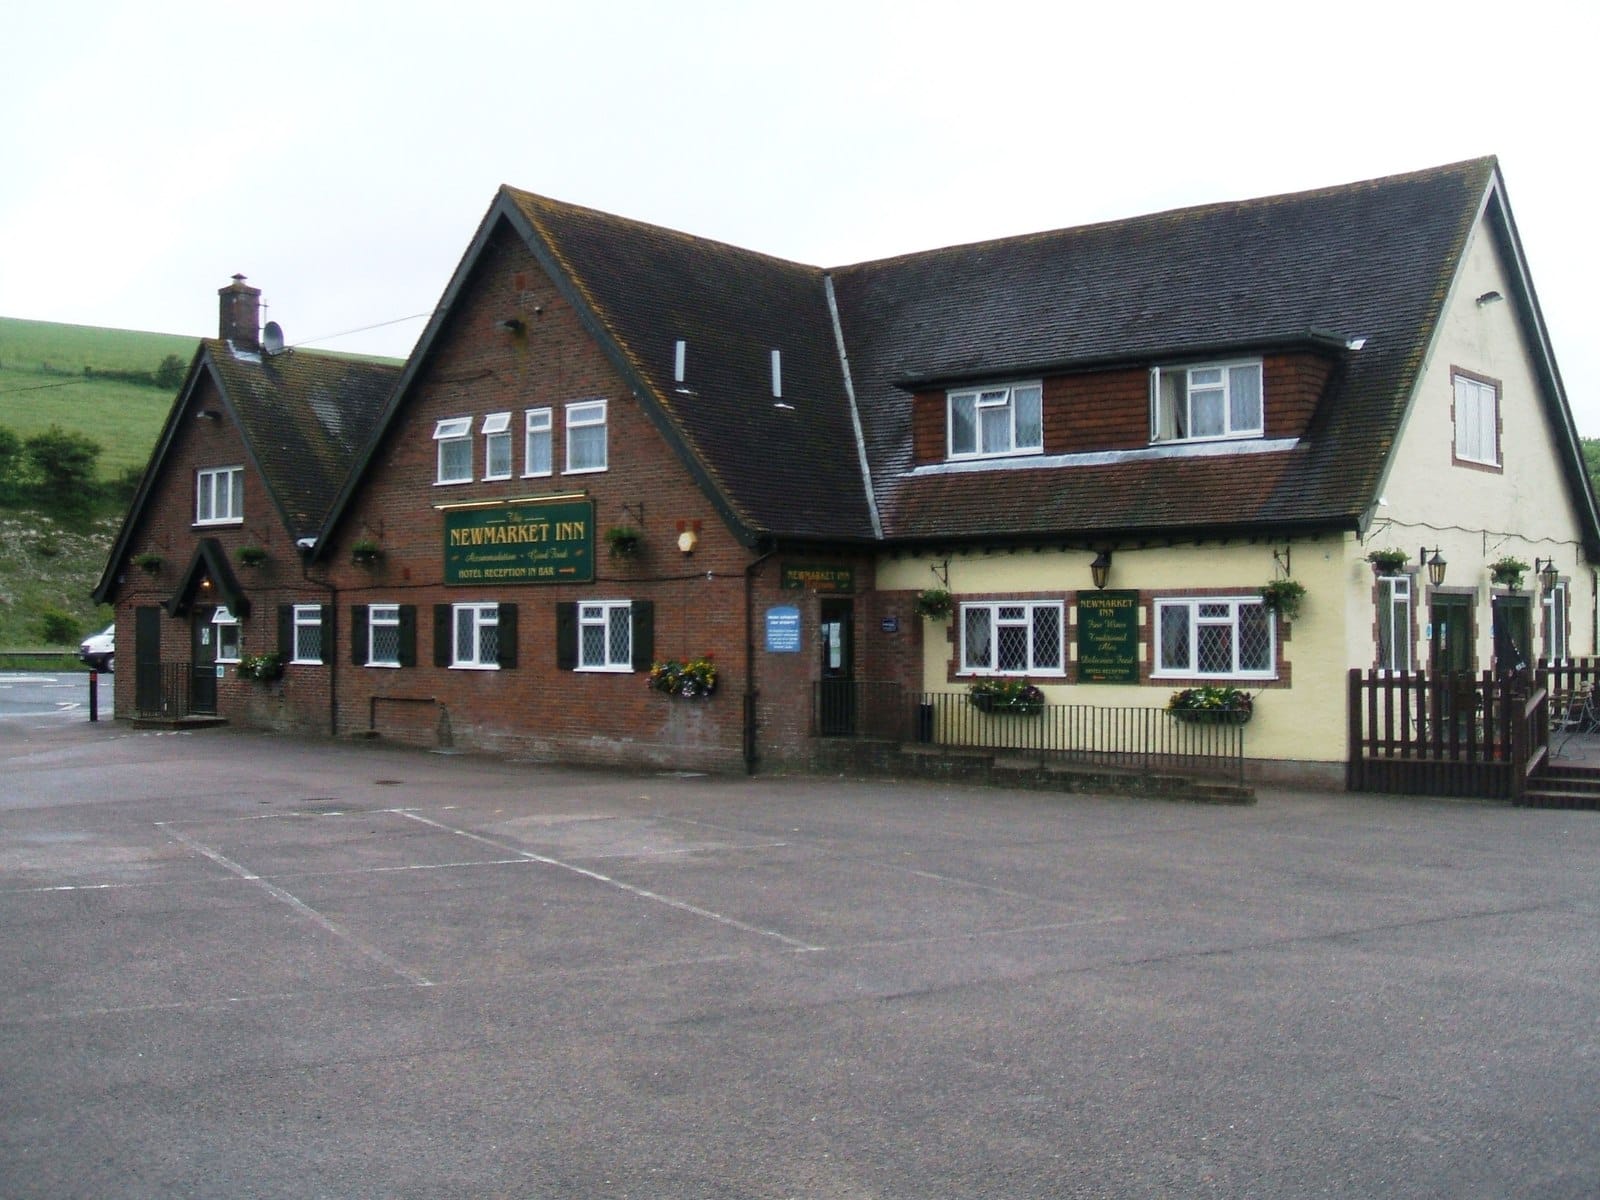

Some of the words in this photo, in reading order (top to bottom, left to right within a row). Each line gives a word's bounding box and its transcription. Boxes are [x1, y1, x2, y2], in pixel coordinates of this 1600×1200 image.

[506, 512, 523, 523] The
[450, 523, 550, 546] NEWMARKET
[555, 521, 585, 541] INN
[458, 568, 481, 579] HOTEL
[484, 567, 526, 578] RECEPTION
[528, 567, 536, 576] IN
[538, 566, 554, 576] BAR
[1081, 600, 1133, 608] NEWMARKET
[1099, 609, 1114, 617] INN
